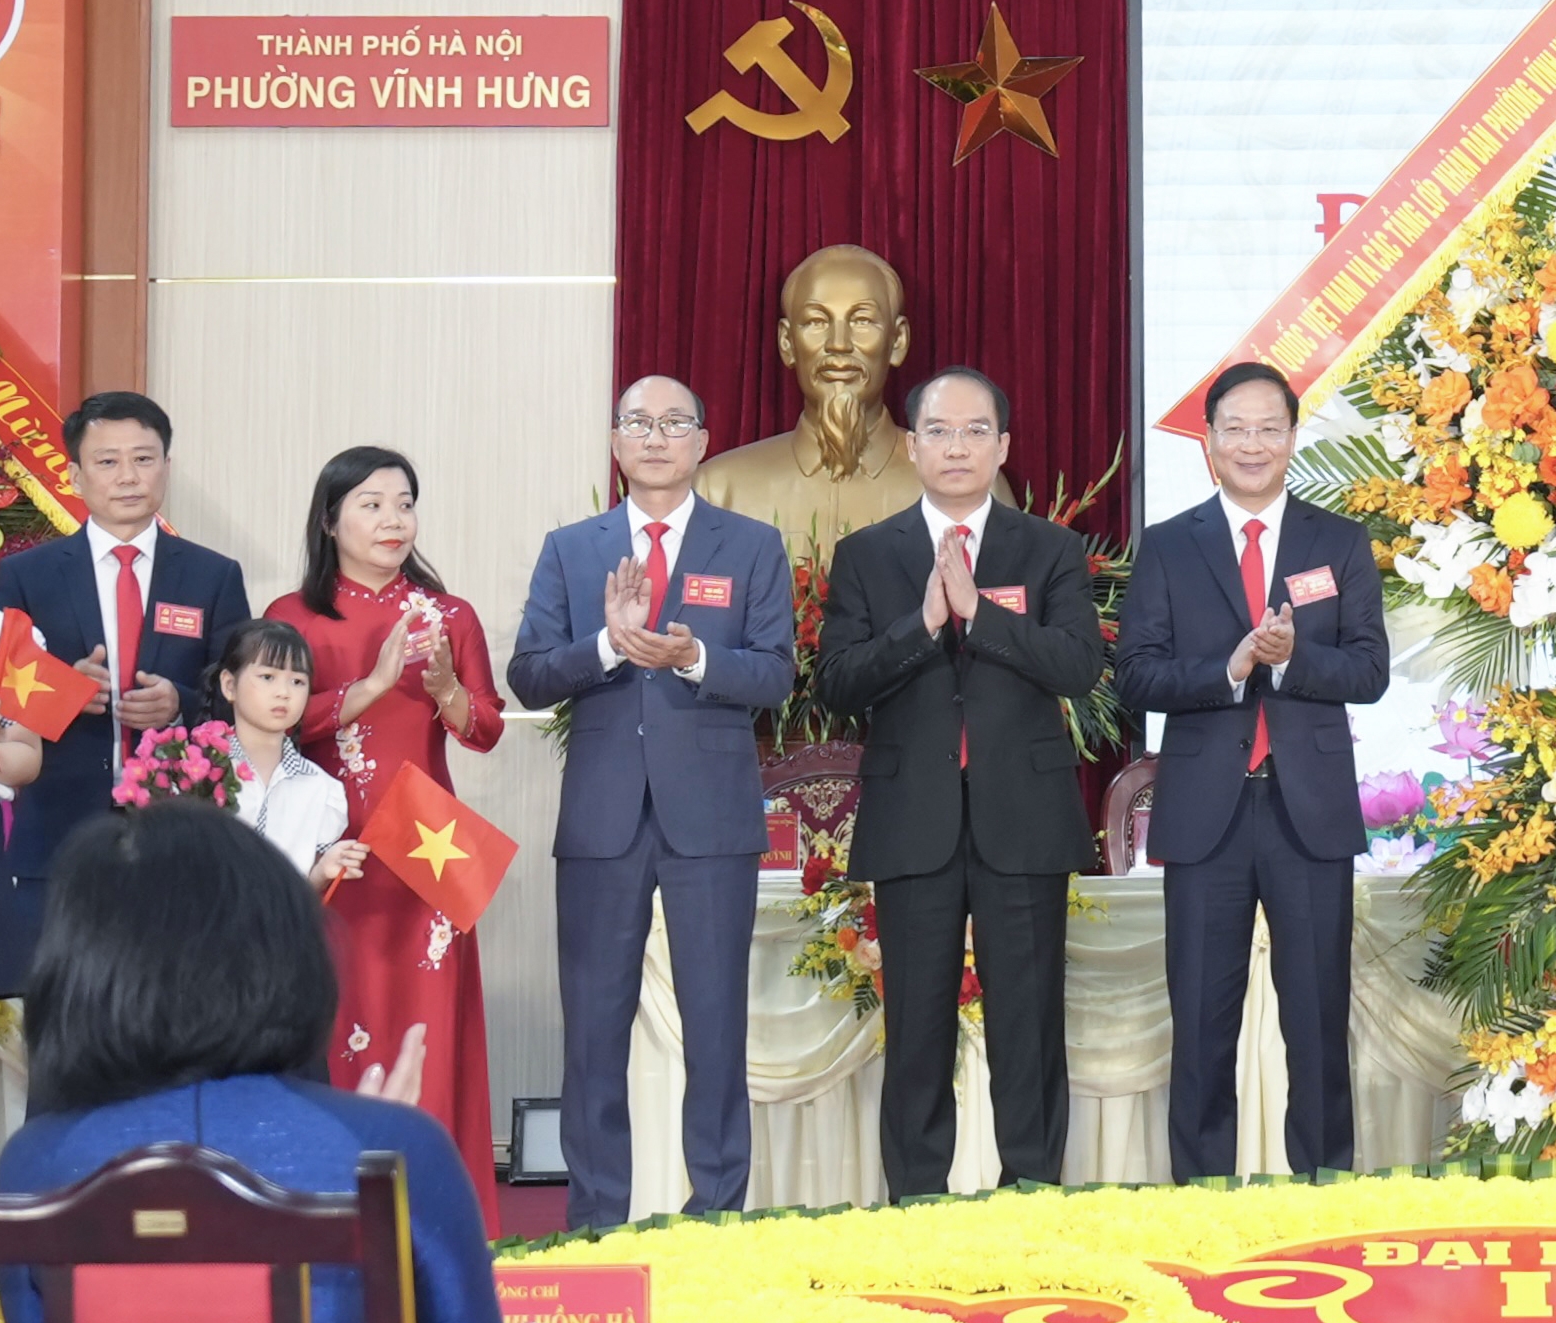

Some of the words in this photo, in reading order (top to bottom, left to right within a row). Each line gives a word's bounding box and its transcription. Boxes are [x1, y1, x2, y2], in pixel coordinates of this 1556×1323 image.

[257, 29, 352, 56] THÀNH
[362, 25, 421, 56] PHỐ
[428, 29, 466, 55] HÀ
[475, 29, 522, 61] NỘI
[187, 65, 356, 109] PHƯỜNG
[370, 68, 461, 108] VĨNH
[477, 73, 591, 108] HƯNG
[1481, 76, 1546, 142] PHƯỜNG
[1459, 122, 1504, 166] DÂN
[1430, 145, 1482, 197] NHÂN
[1409, 178, 1450, 220] LỚP
[1379, 200, 1433, 248] TẦNG
[1345, 249, 1384, 289] VÀ
[1361, 231, 1404, 272] CÁC
[1320, 270, 1368, 316] NAM
[1297, 296, 1344, 340] VIỆT
[1269, 318, 1319, 373] QUỐC
[1361, 1239, 1513, 1271] ĐẠI
[531, 1281, 560, 1298] CHÍ
[1499, 1271, 1554, 1318] I
